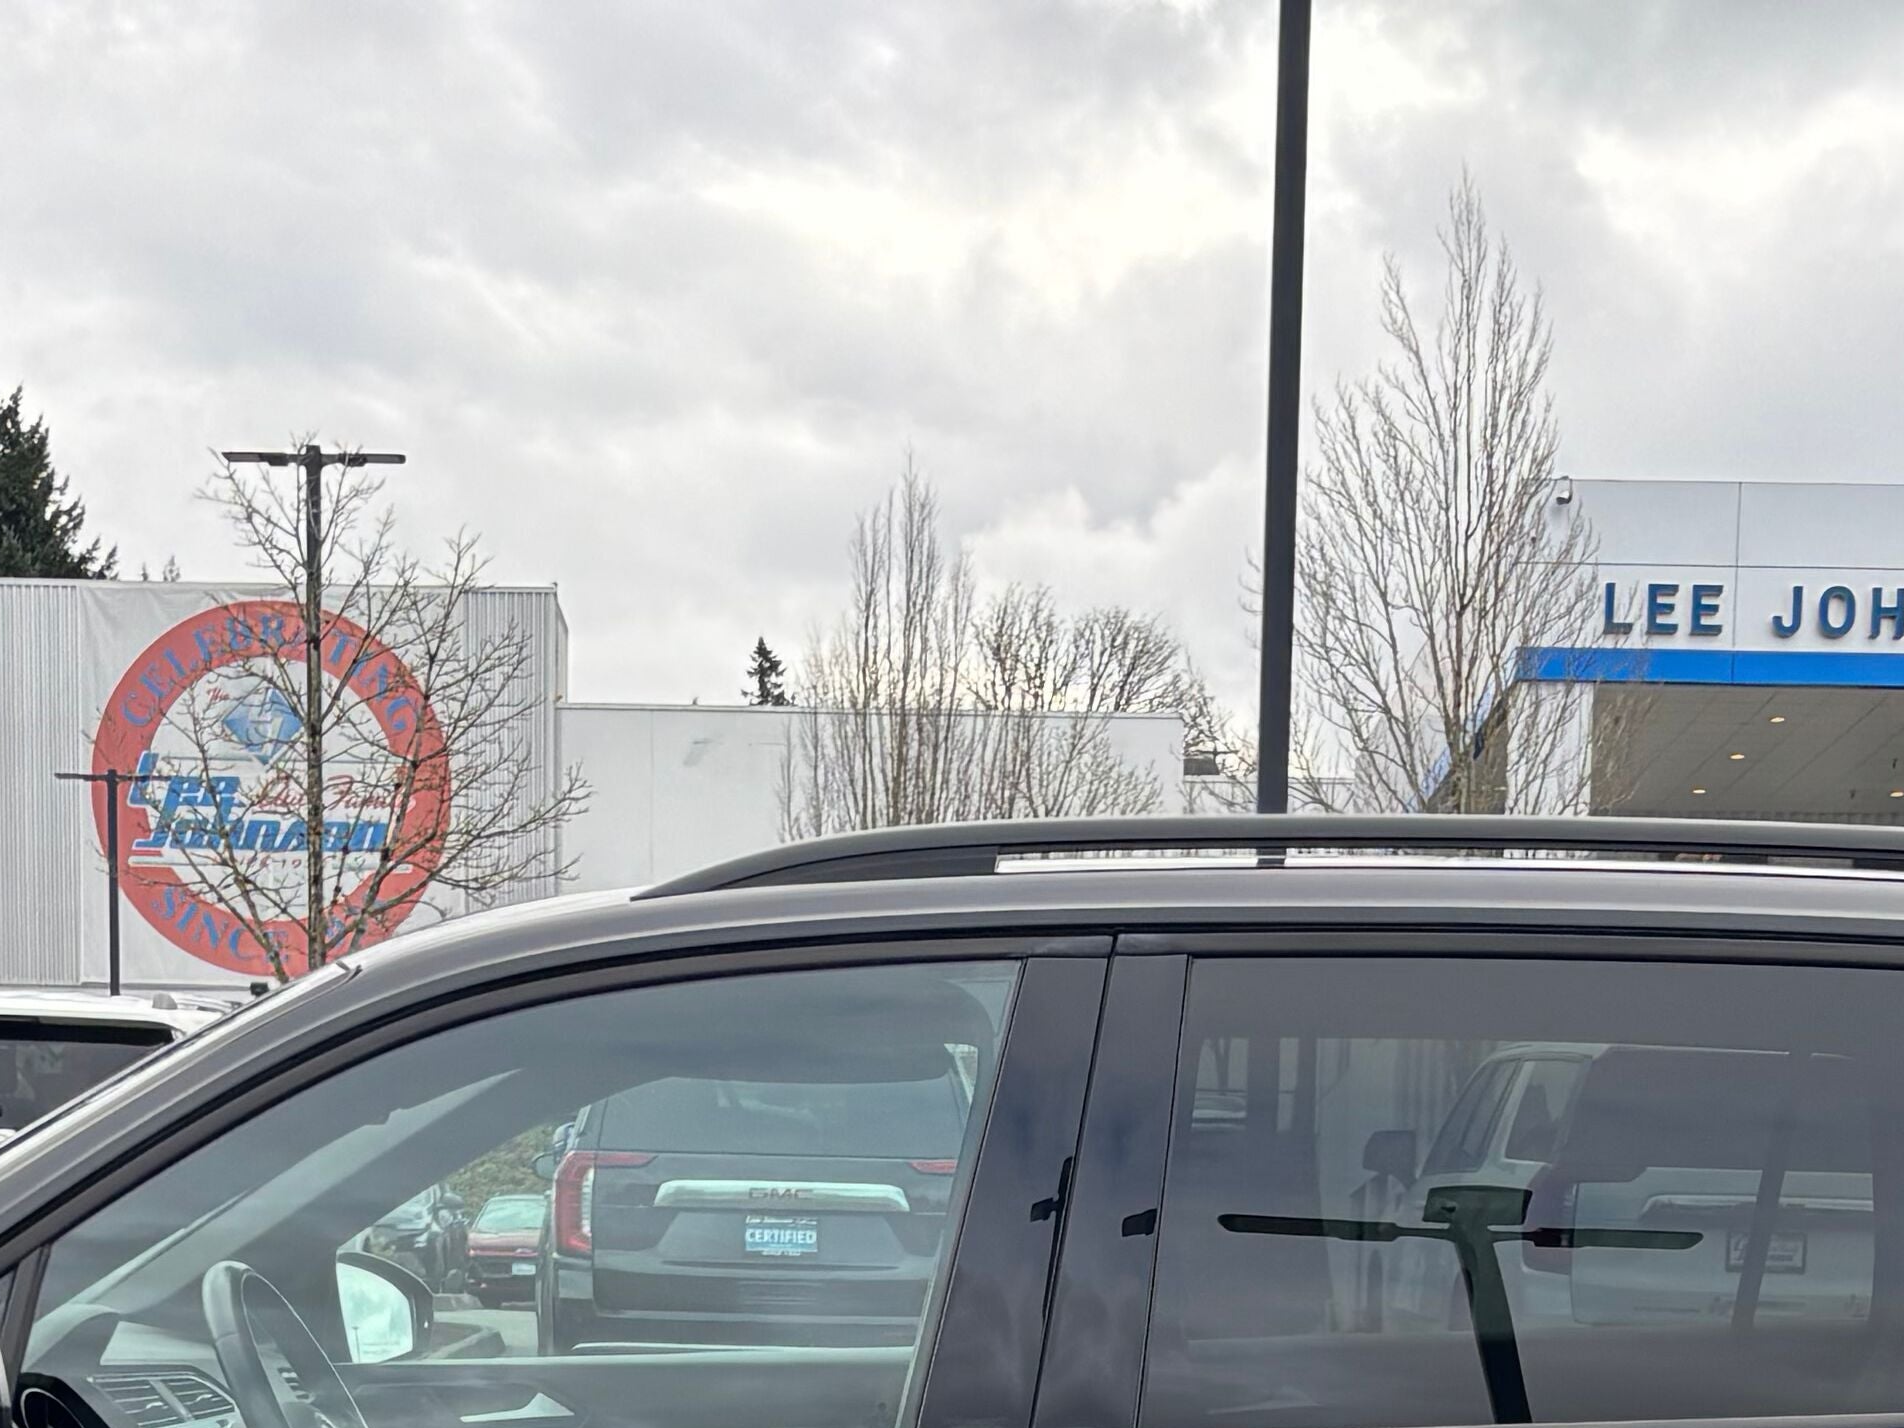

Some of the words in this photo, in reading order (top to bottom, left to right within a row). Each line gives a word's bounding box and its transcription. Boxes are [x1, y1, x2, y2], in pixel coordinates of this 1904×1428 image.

[1603, 582, 1724, 637] LEE
[120, 613, 420, 733] CELEBRTING
[749, 1187, 814, 1200] GMC
[745, 1229, 818, 1244] CERTIFIED
